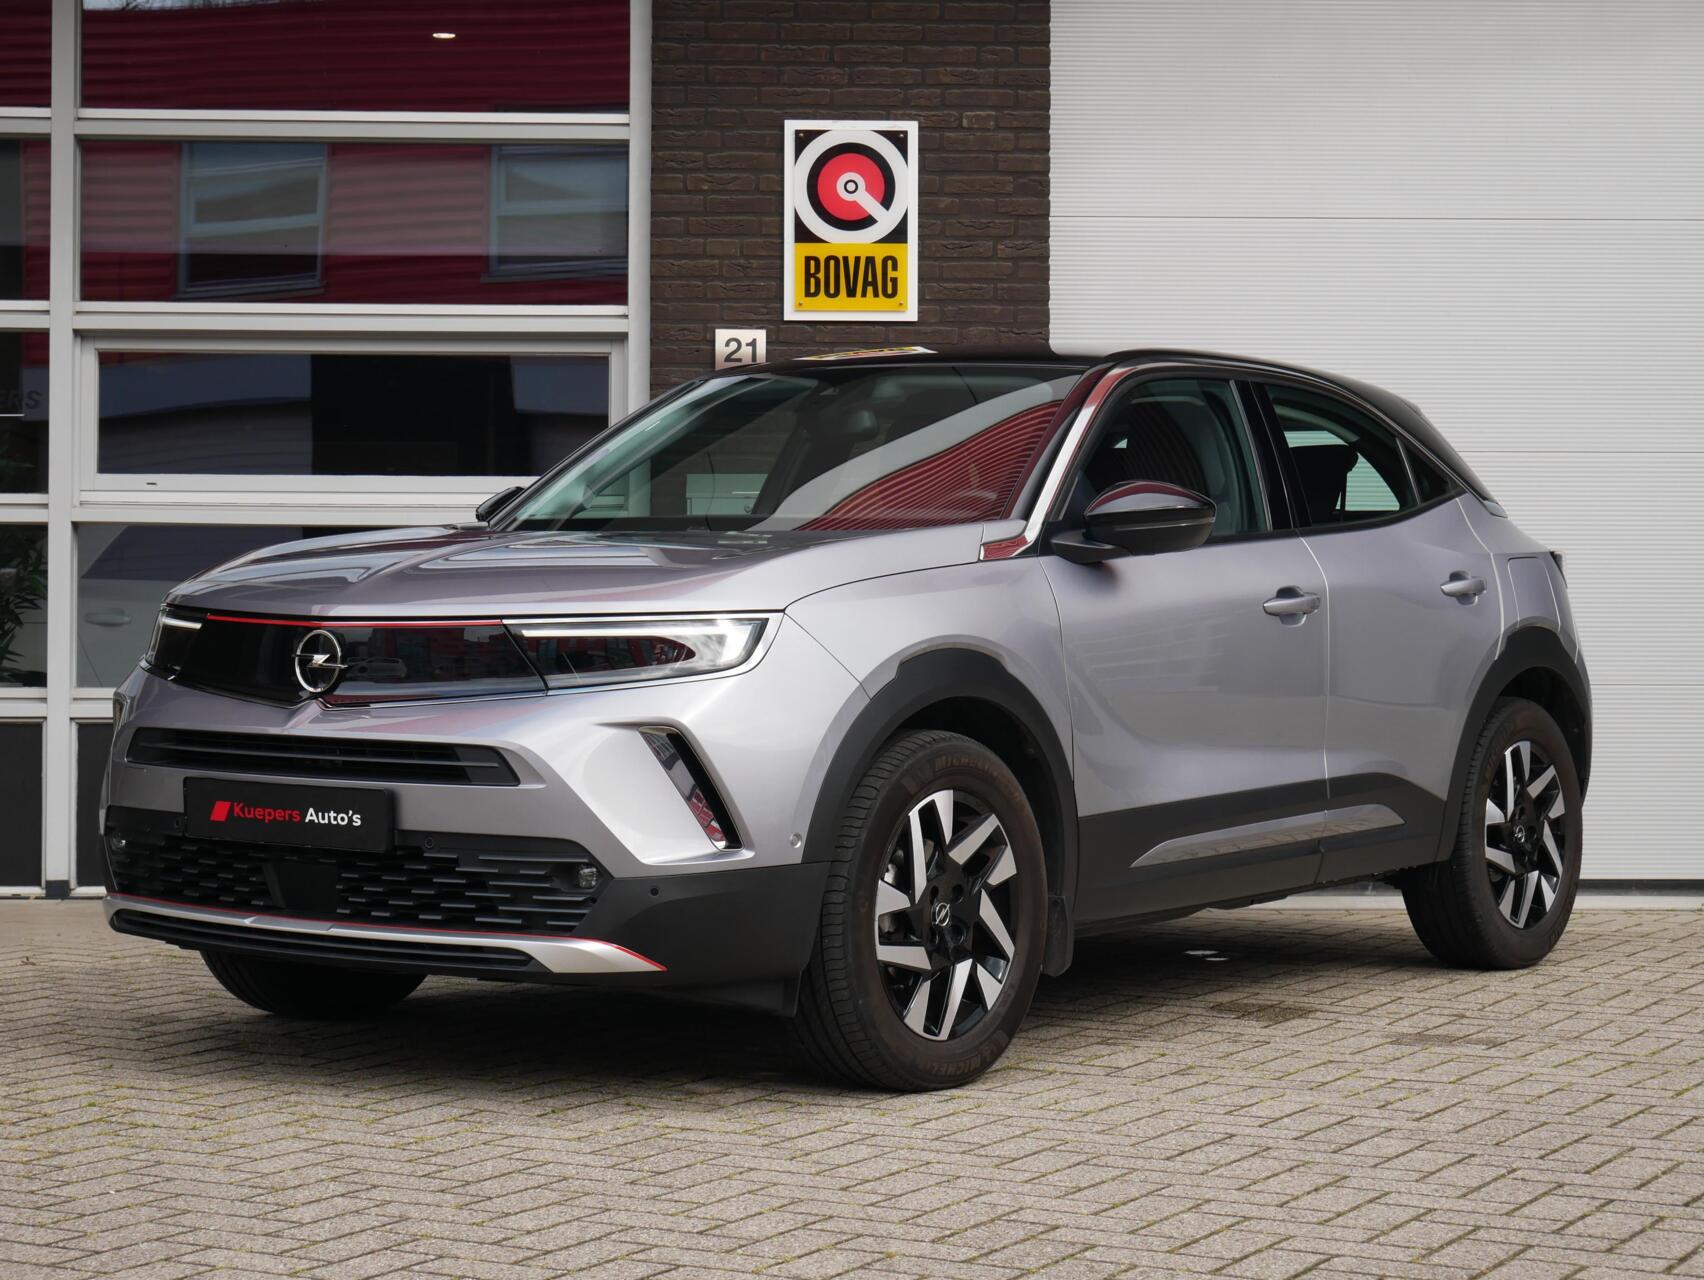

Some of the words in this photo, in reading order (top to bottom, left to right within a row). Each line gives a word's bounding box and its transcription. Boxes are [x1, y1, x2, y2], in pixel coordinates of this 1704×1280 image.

[803, 254, 899, 299] BOVAG
[723, 337, 758, 363] 21
[233, 802, 301, 824] Kuepers
[304, 807, 362, 827] Auto's
